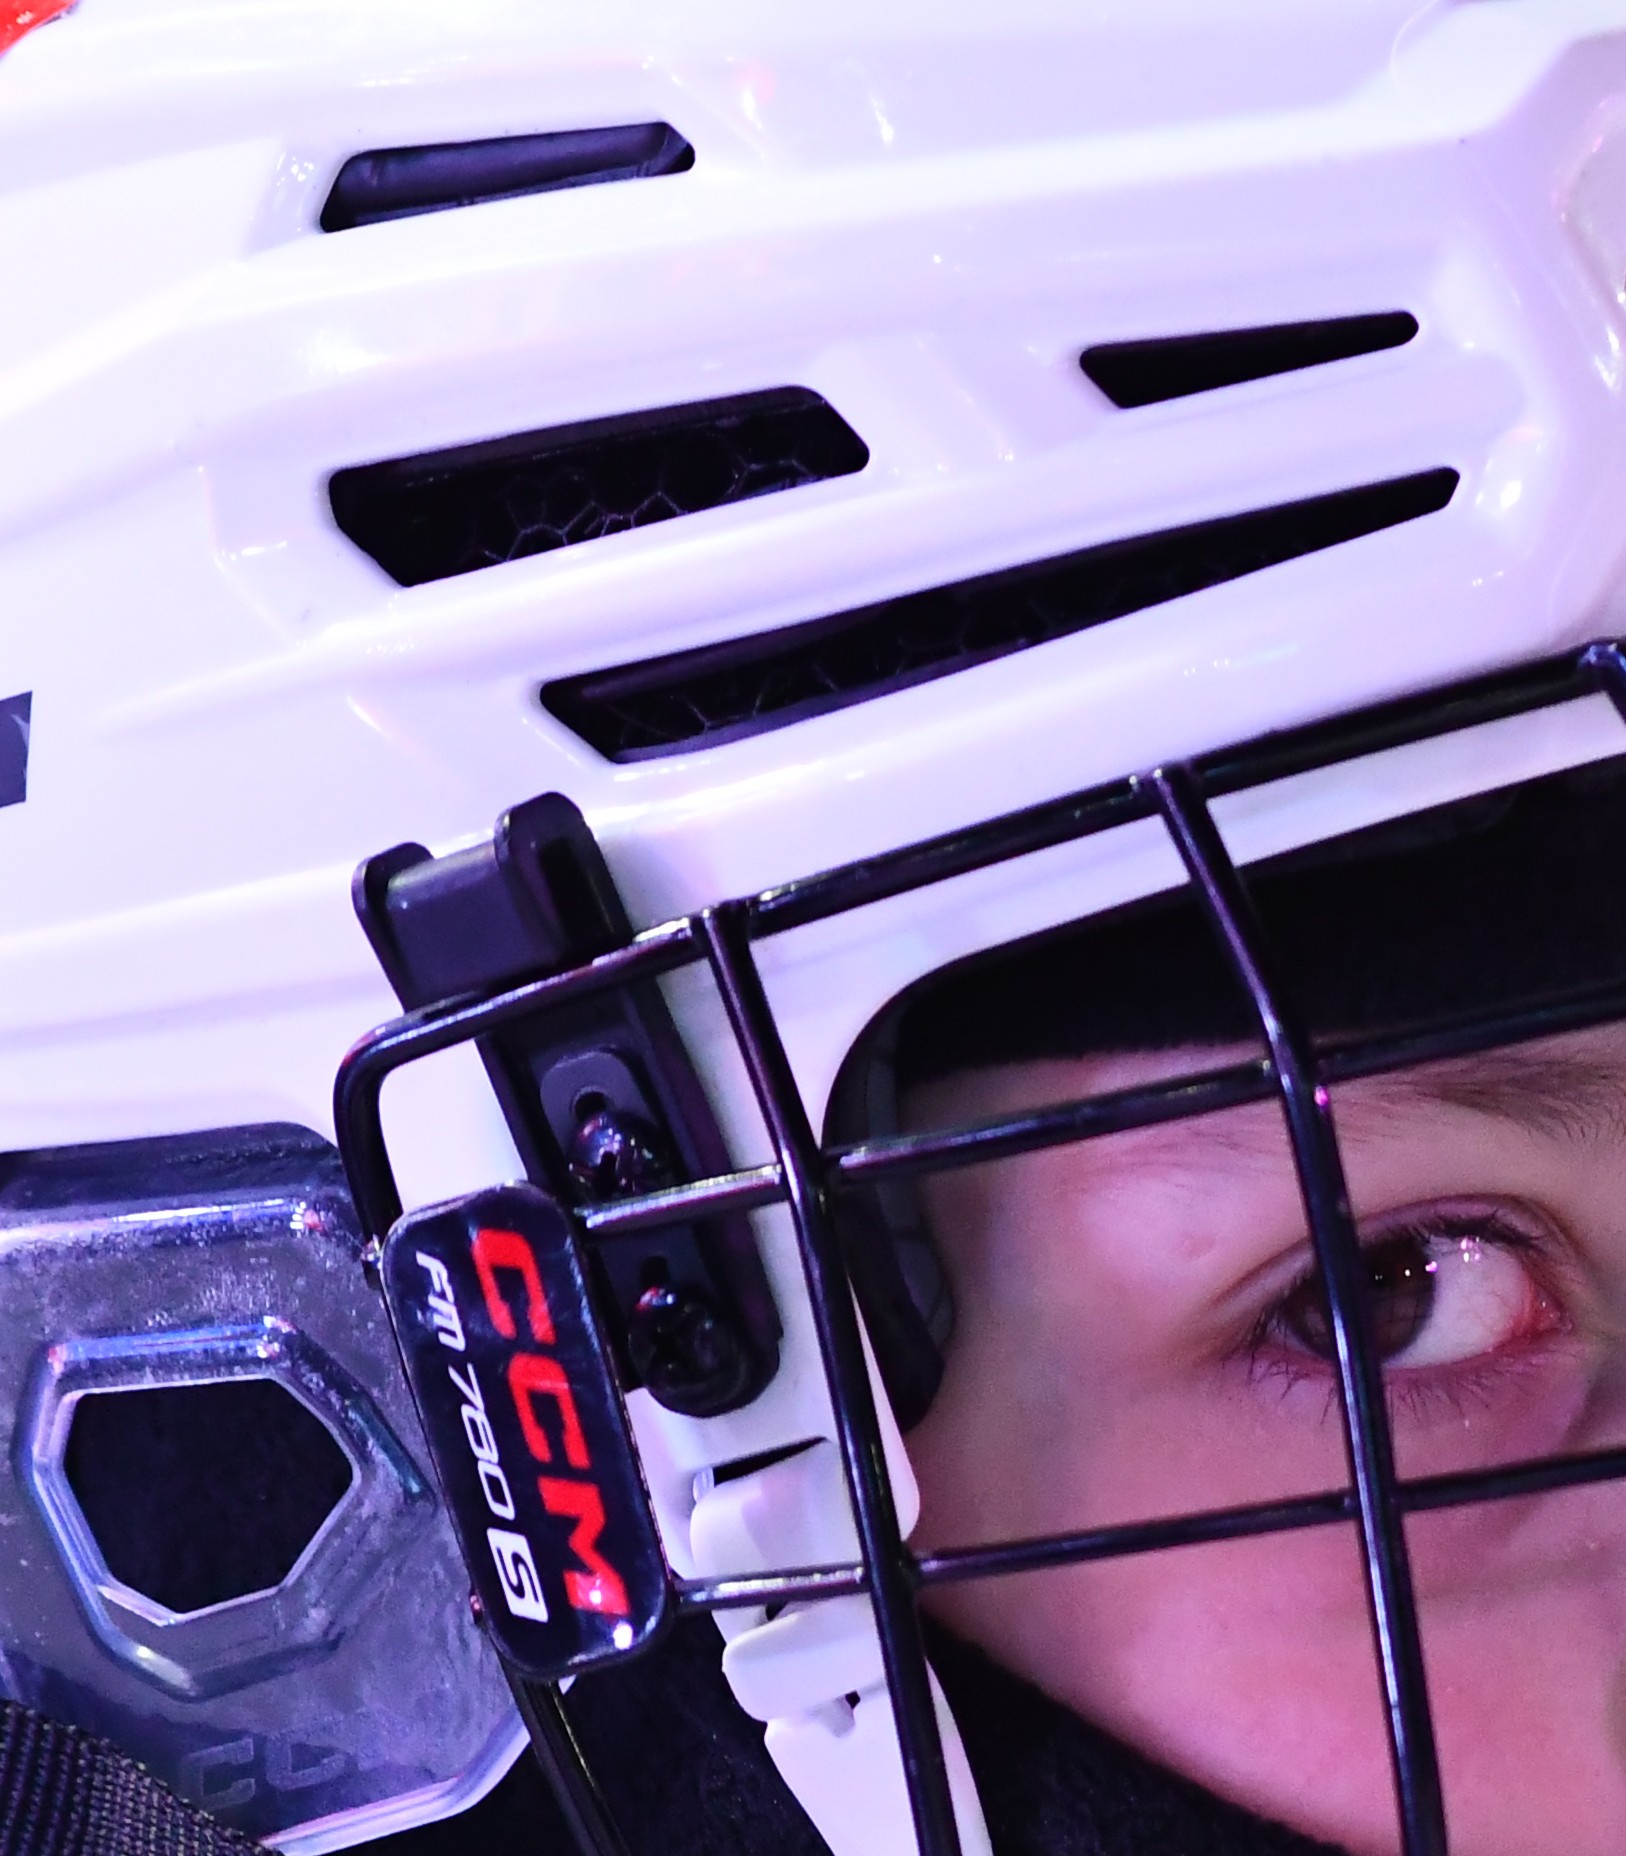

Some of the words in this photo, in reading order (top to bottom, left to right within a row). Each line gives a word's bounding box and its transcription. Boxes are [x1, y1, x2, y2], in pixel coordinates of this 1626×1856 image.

[415, 1250, 467, 1352] FM
[447, 1362, 516, 1521] 780
[470, 1228, 631, 1616] CCM
